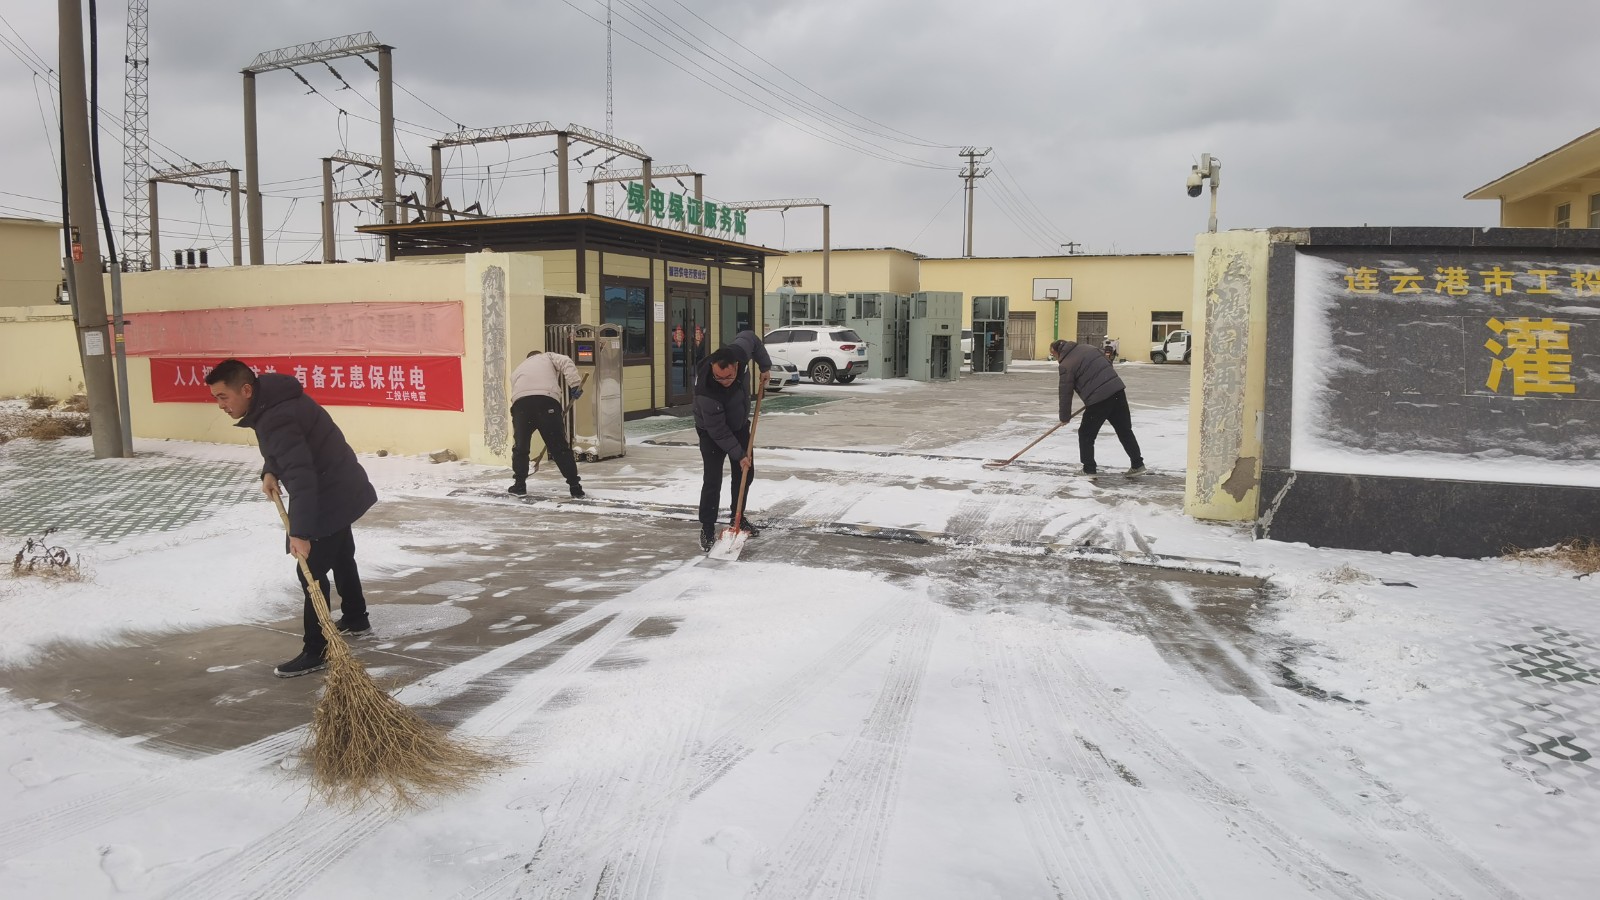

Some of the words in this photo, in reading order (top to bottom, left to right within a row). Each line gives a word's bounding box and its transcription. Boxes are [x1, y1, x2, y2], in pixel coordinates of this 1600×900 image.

[627, 181, 747, 236] 绿电绿证服务站
[1343, 266, 1600, 297] 连云港市工投
[1483, 316, 1576, 396] 灌
[294, 364, 427, 391] 有备无患保供电
[385, 390, 427, 402] 工投供电宣
